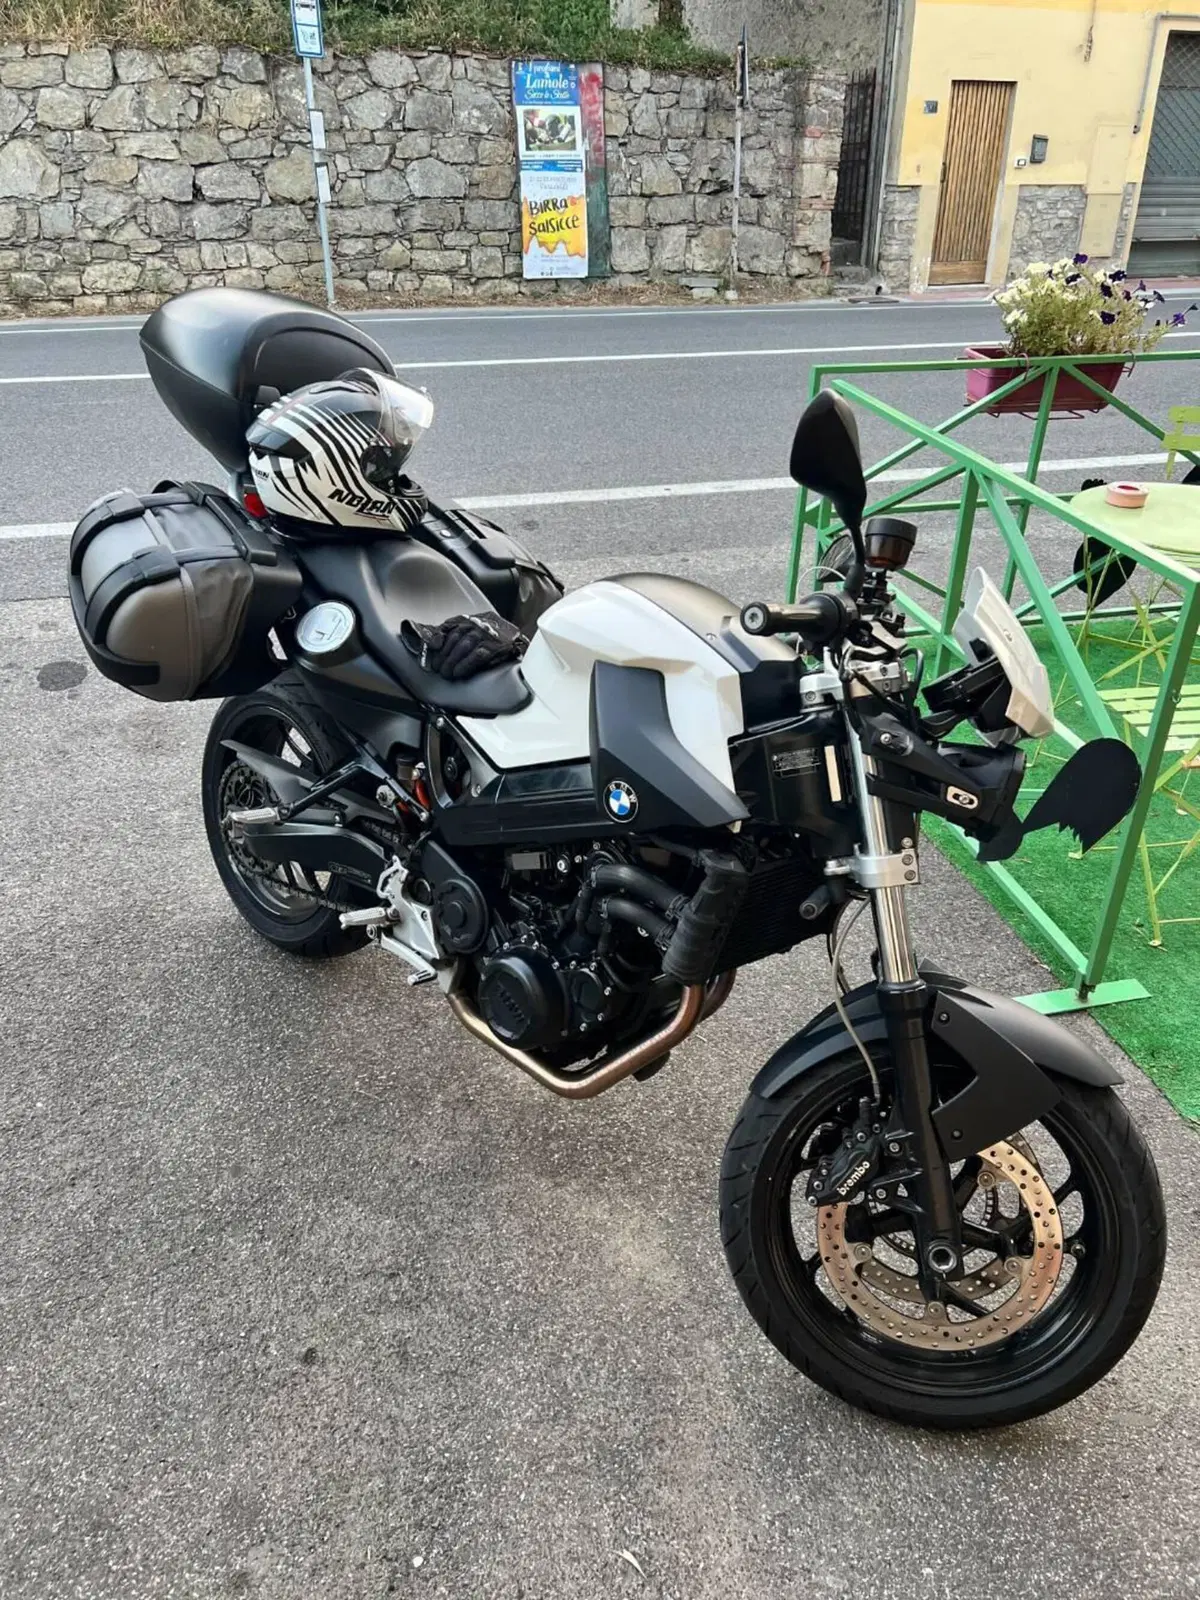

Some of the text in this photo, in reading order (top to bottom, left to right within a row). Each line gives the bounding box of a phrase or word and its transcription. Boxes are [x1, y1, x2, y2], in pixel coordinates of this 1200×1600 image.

[526, 73, 569, 89] Lamole
[328, 488, 397, 516] NOLAN
[836, 1160, 870, 1197] brembo
